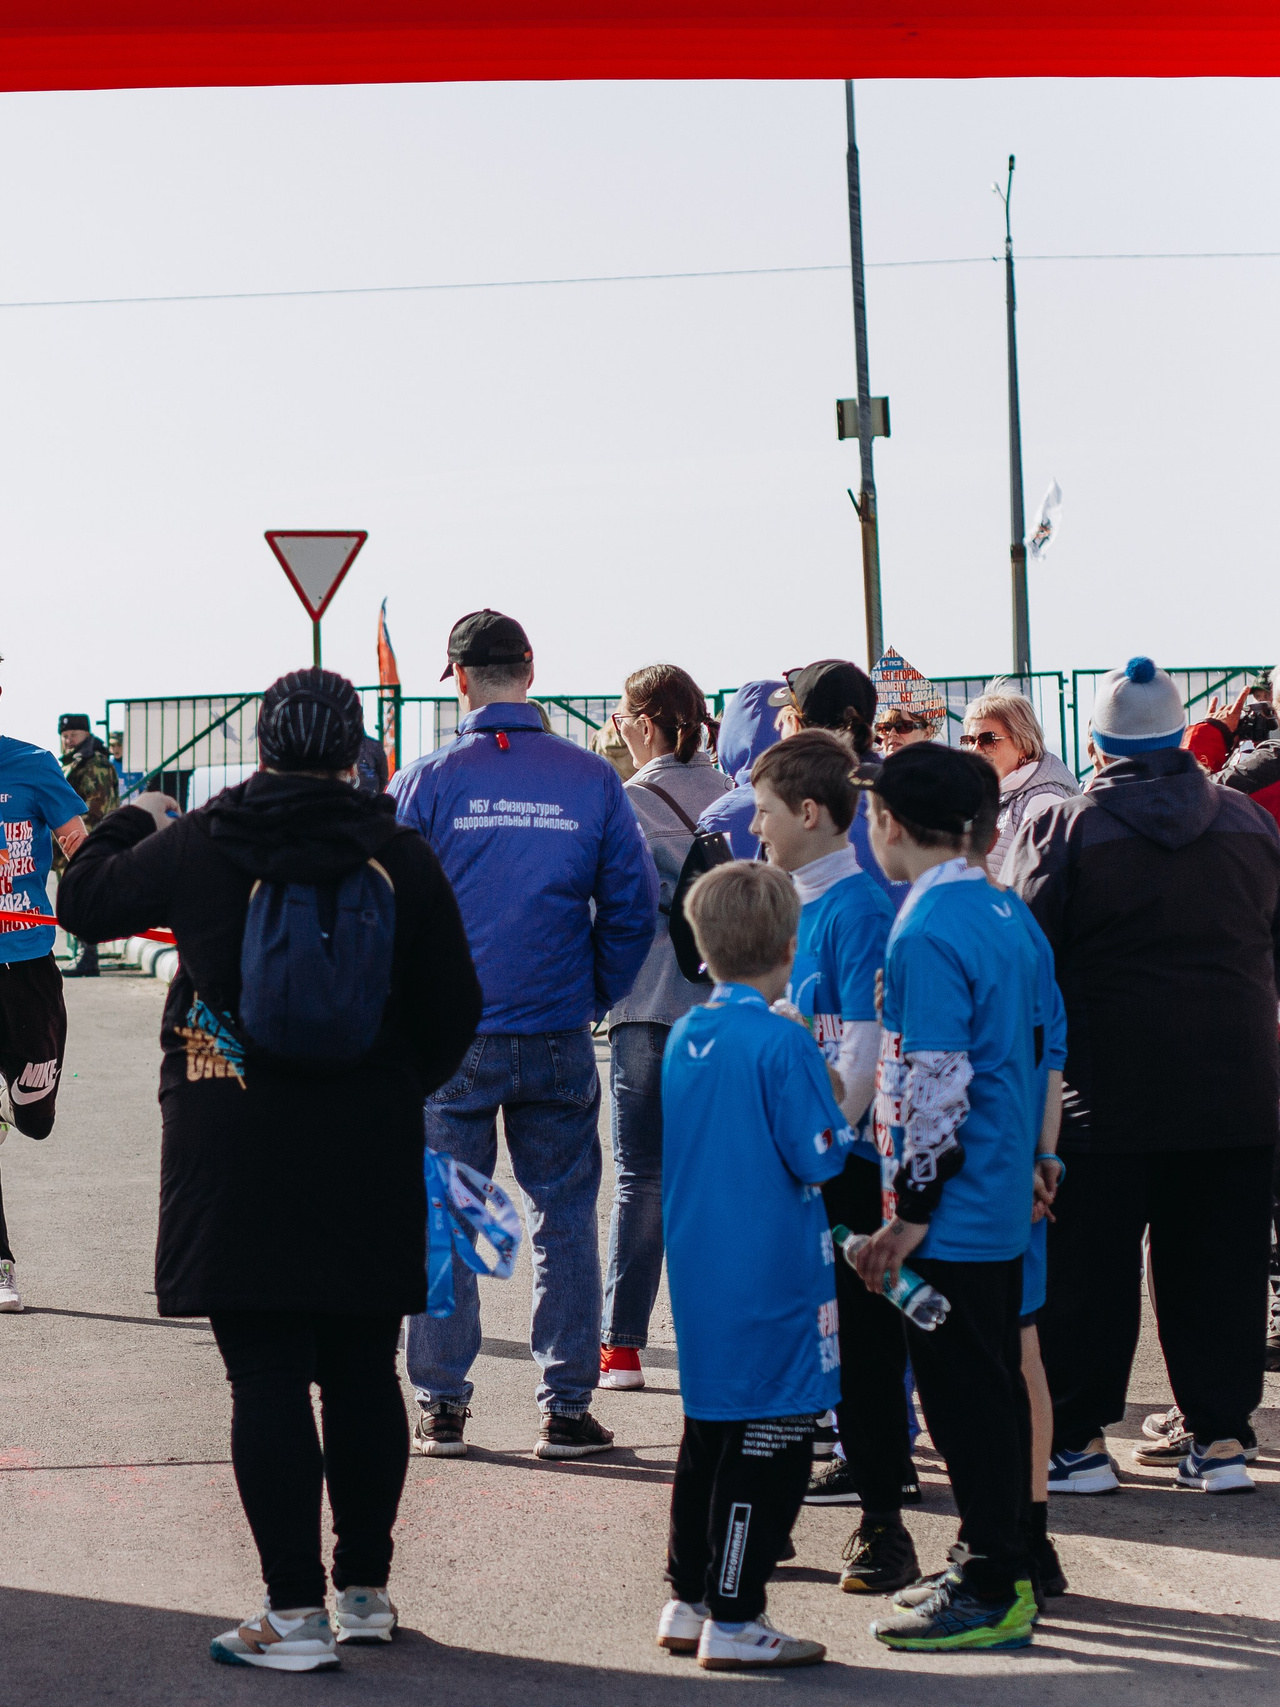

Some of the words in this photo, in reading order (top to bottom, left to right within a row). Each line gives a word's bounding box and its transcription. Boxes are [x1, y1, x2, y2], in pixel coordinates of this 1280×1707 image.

[470, 799, 490, 814] МБУ
[492, 799, 564, 817] «Физкультурно-
[453, 814, 531, 831] оздоровительный
[533, 818, 579, 832] комплекс»
[19, 1058, 57, 1088] NIKE
[744, 1431, 773, 1441] nothing
[724, 1520, 745, 1591] #nocomment
